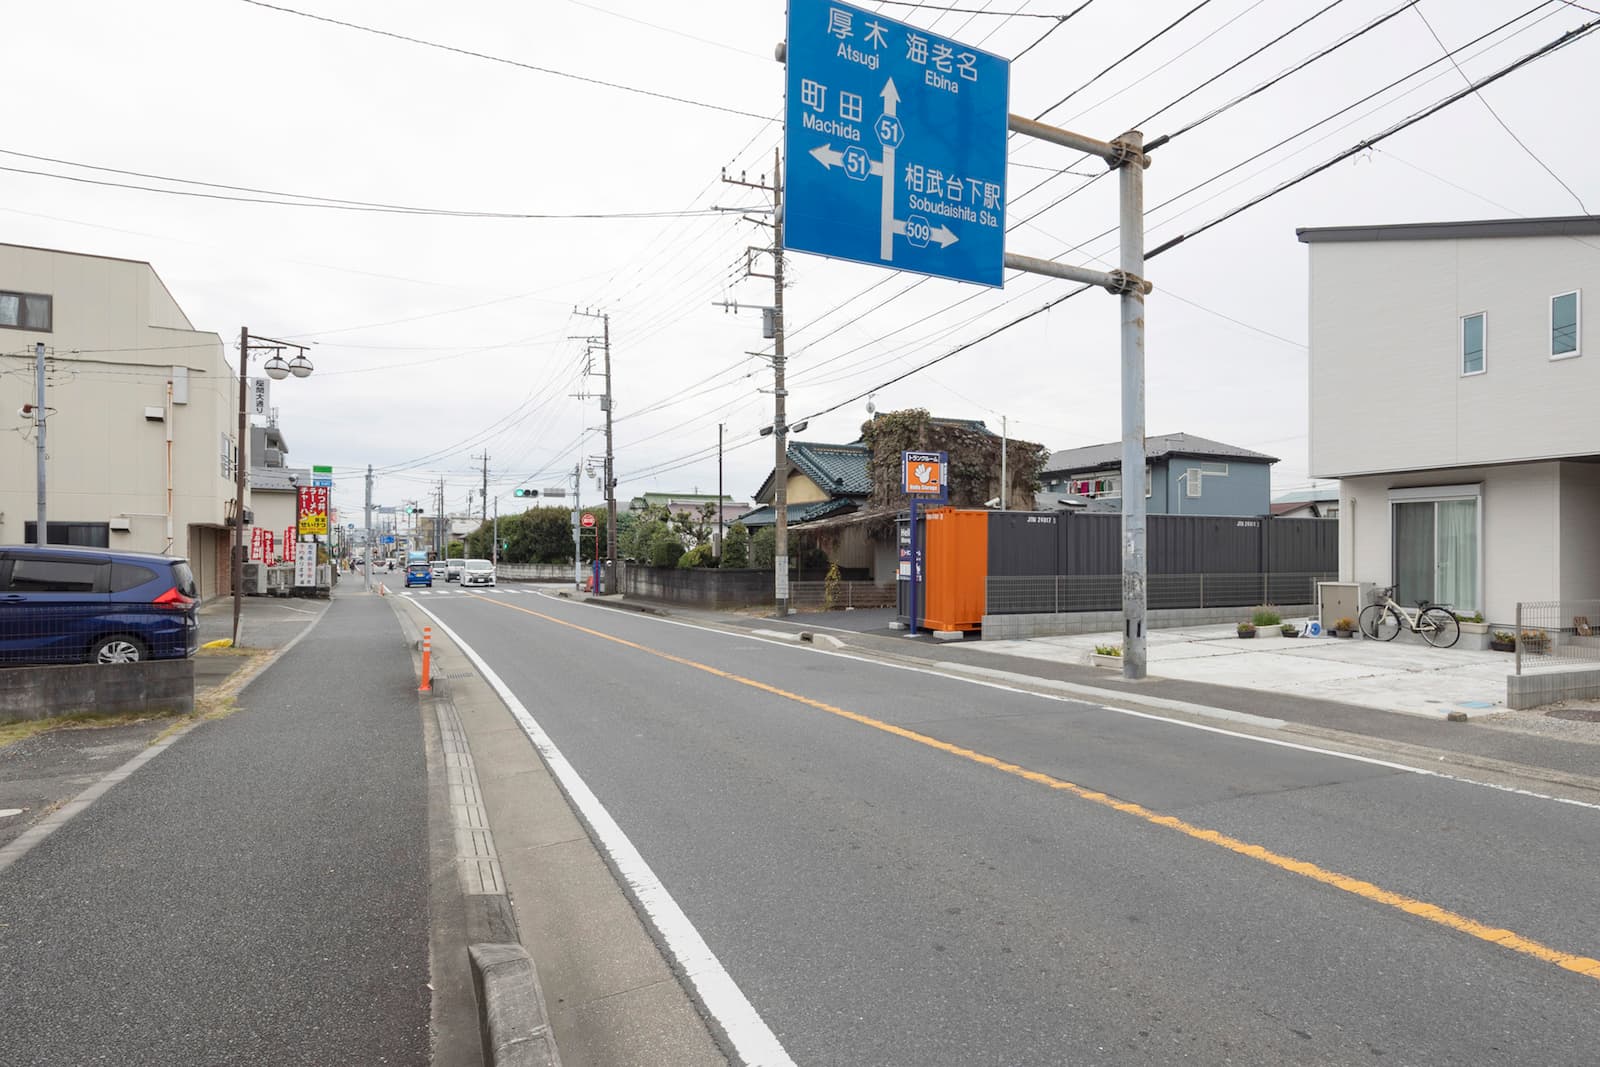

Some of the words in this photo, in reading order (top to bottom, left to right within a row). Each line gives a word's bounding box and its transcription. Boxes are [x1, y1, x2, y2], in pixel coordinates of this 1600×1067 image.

[827, 7, 889, 50] 厚木
[836, 42, 880, 71] Atsugi
[905, 33, 978, 83] 海老名
[925, 70, 959, 94] Ebina
[801, 78, 863, 123] 町田
[802, 112, 861, 141] Machida
[880, 119, 898, 142] 51
[847, 152, 866, 175] 51
[905, 162, 1001, 211] 相武台下駅
[909, 194, 977, 223] Sobudaishita
[907, 222, 930, 241] 509
[309, 488, 317, 516] ラーメン
